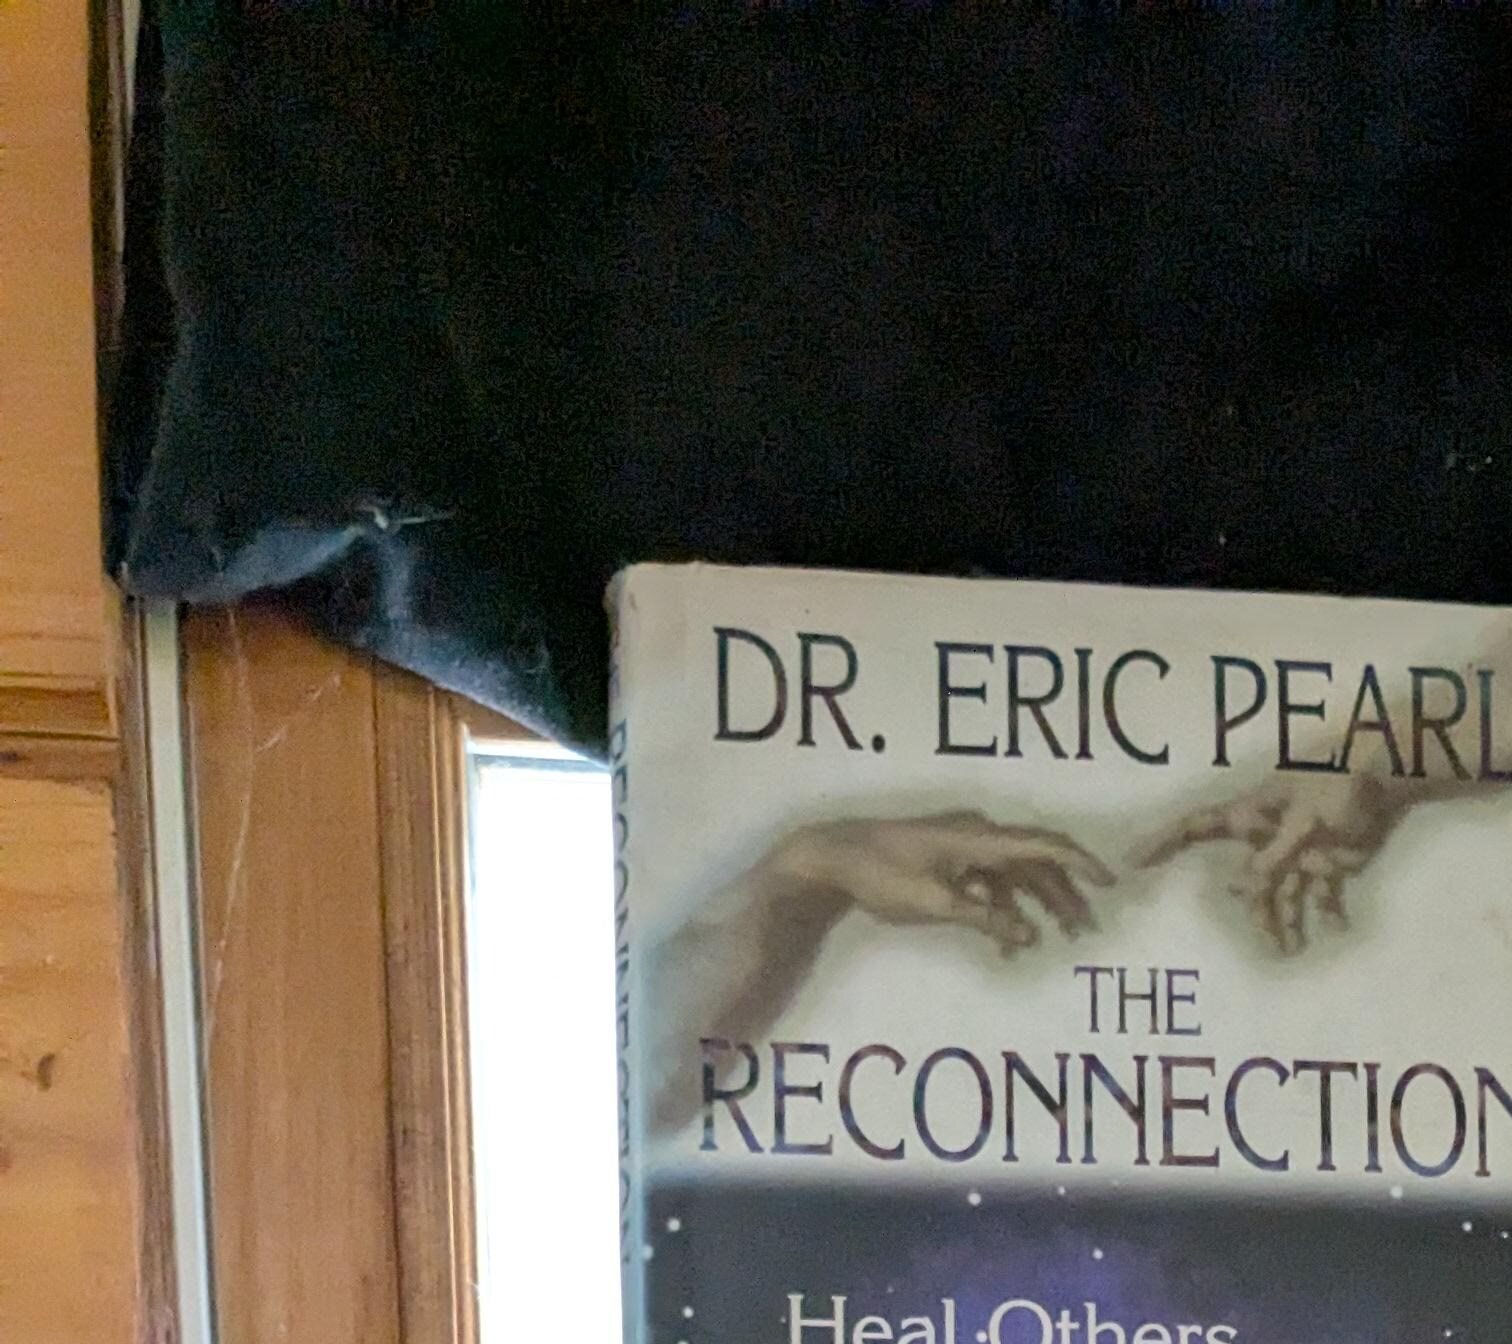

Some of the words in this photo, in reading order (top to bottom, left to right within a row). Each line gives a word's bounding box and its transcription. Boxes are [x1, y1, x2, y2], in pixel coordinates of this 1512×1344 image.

[712, 626, 886, 753] DR.
[933, 640, 1171, 765] ERIC
[1073, 965, 1200, 1035] THE
